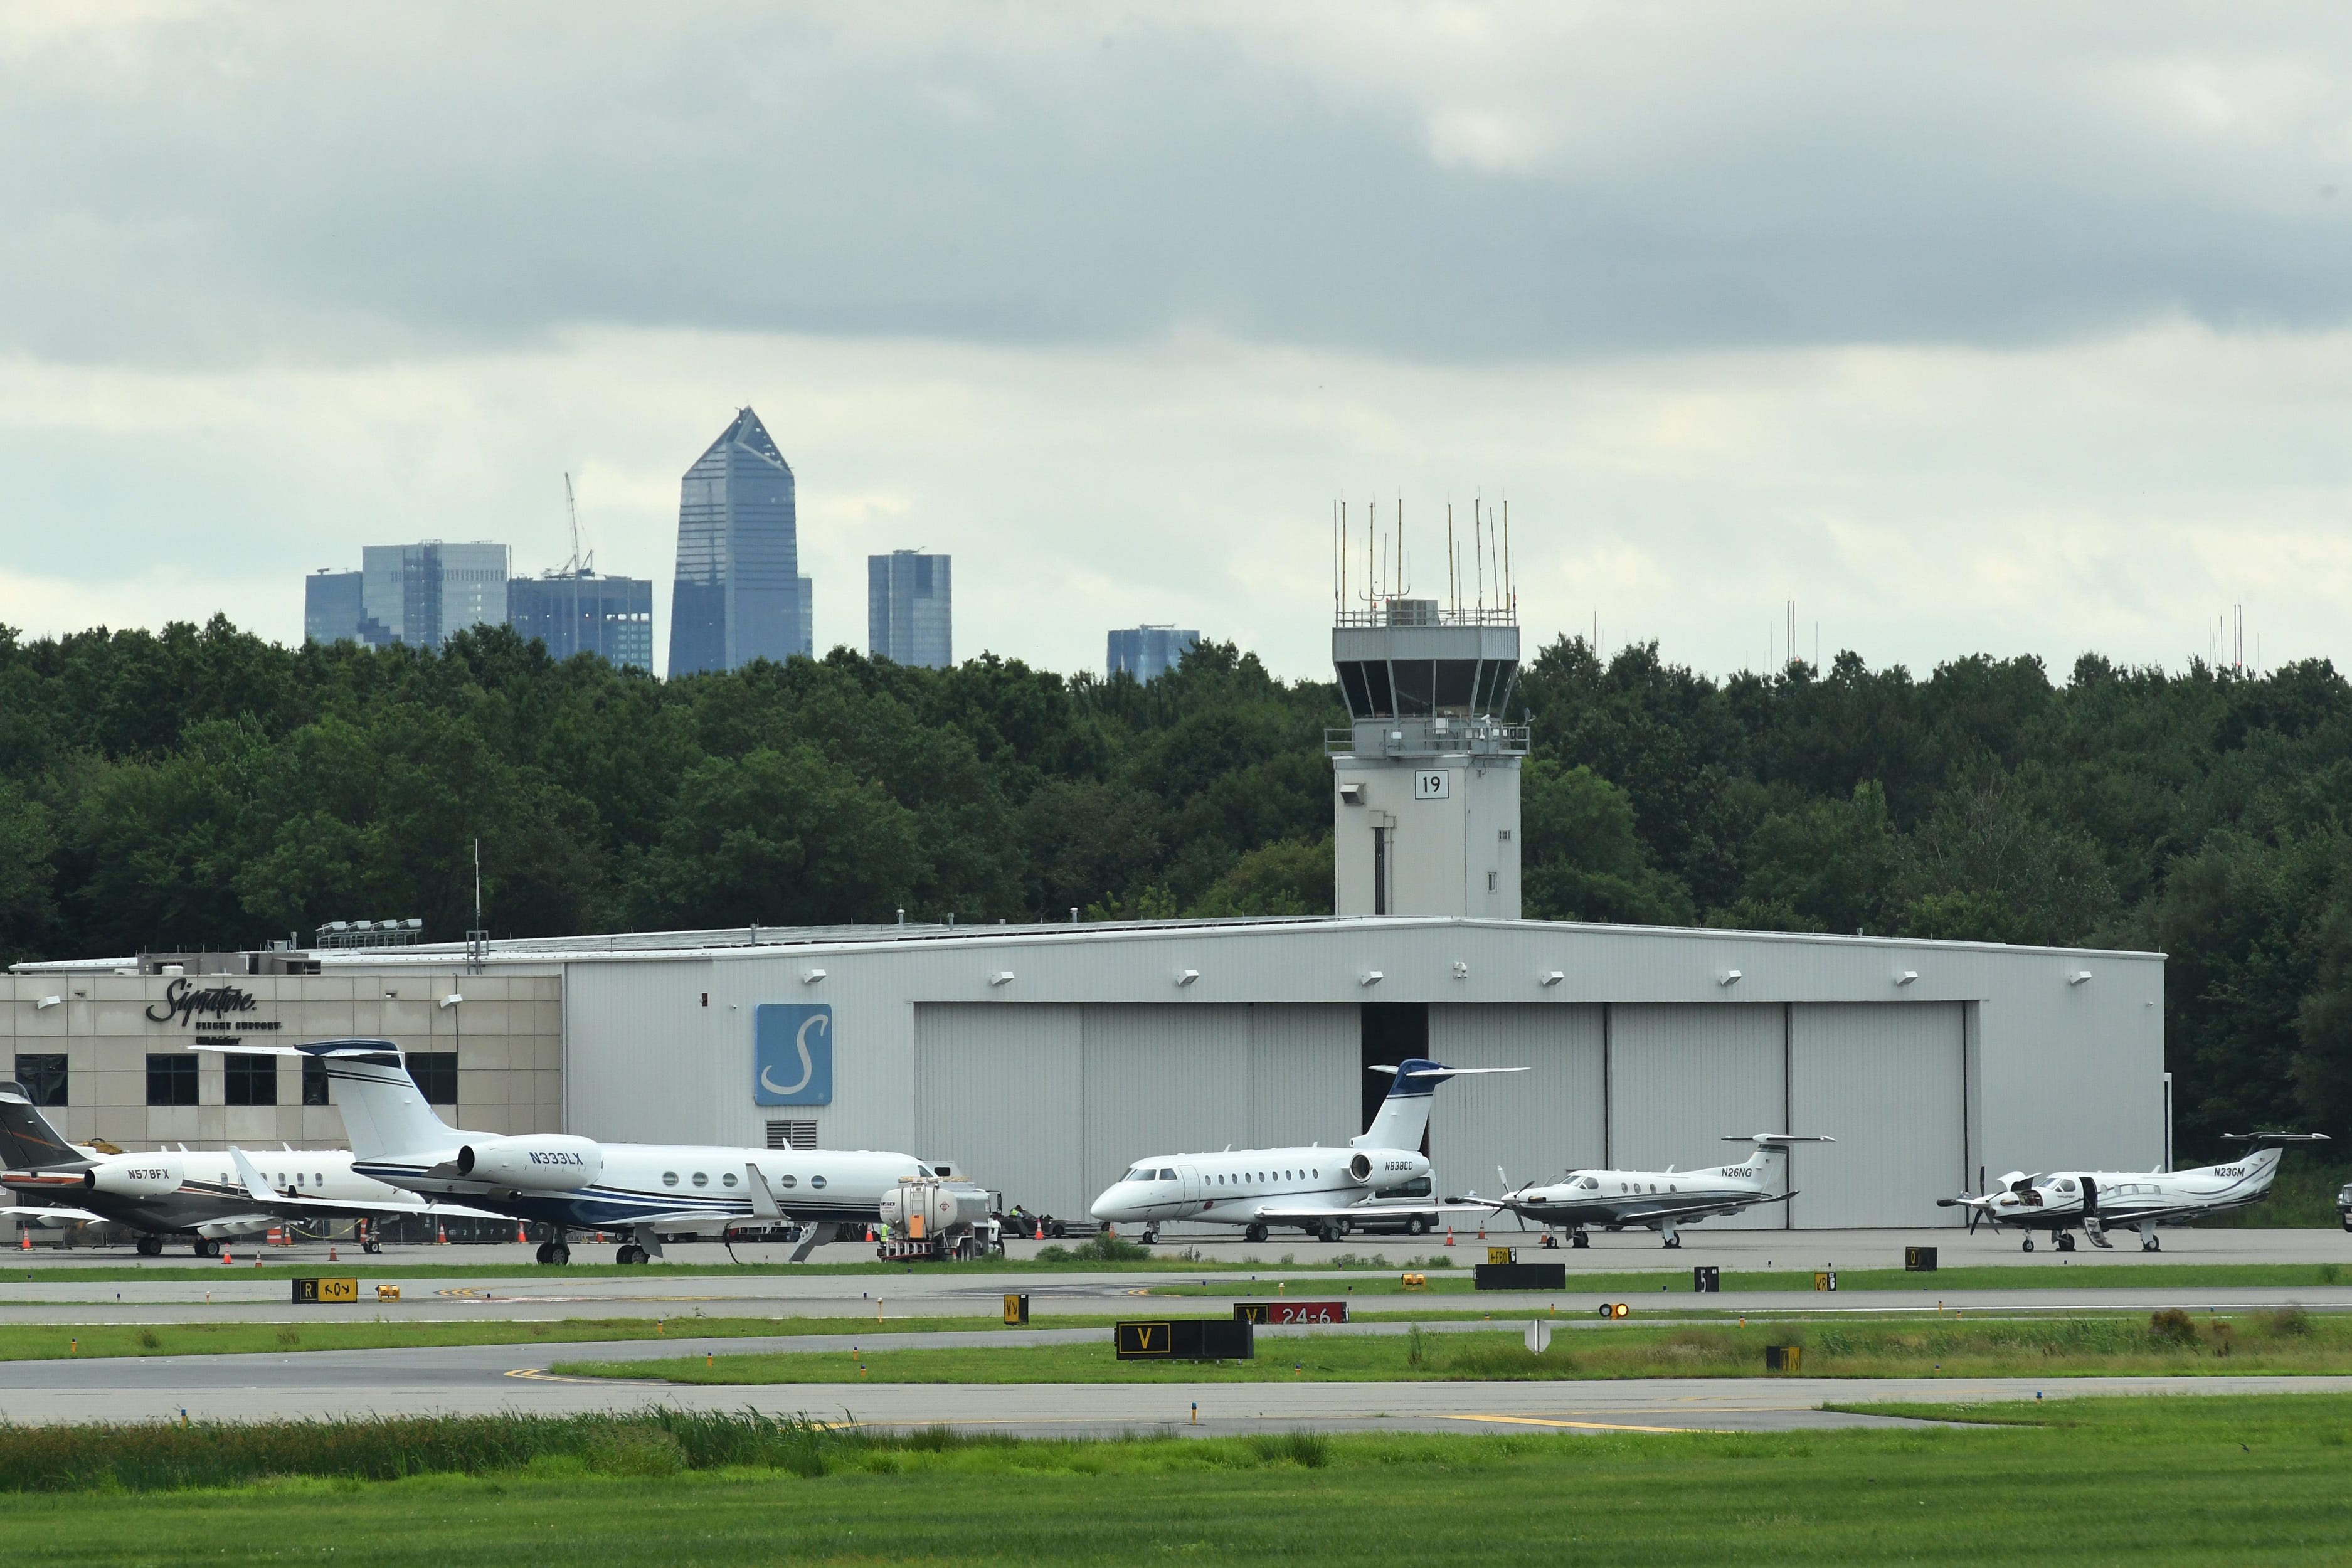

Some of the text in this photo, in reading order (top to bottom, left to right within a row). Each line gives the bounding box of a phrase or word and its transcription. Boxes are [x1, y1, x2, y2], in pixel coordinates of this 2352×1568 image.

[1423, 776, 1441, 793] 19
[146, 978, 256, 1027] Signature
[196, 1022, 281, 1030] FLIGHT SUPPORT
[761, 1014, 829, 1094] S
[529, 1152, 583, 1165] N333LX
[1385, 1161, 1412, 1171] N838CC
[1722, 1168, 1752, 1177] N26NG
[2214, 1167, 2245, 1177] N23GM
[127, 1168, 169, 1179] N578FX
[1496, 1251, 1507, 1264] FBO
[1700, 1269, 1706, 1293] 5
[305, 1283, 312, 1298] R
[1283, 1308, 1330, 1324] 24-6
[1138, 1328, 1152, 1349] V
